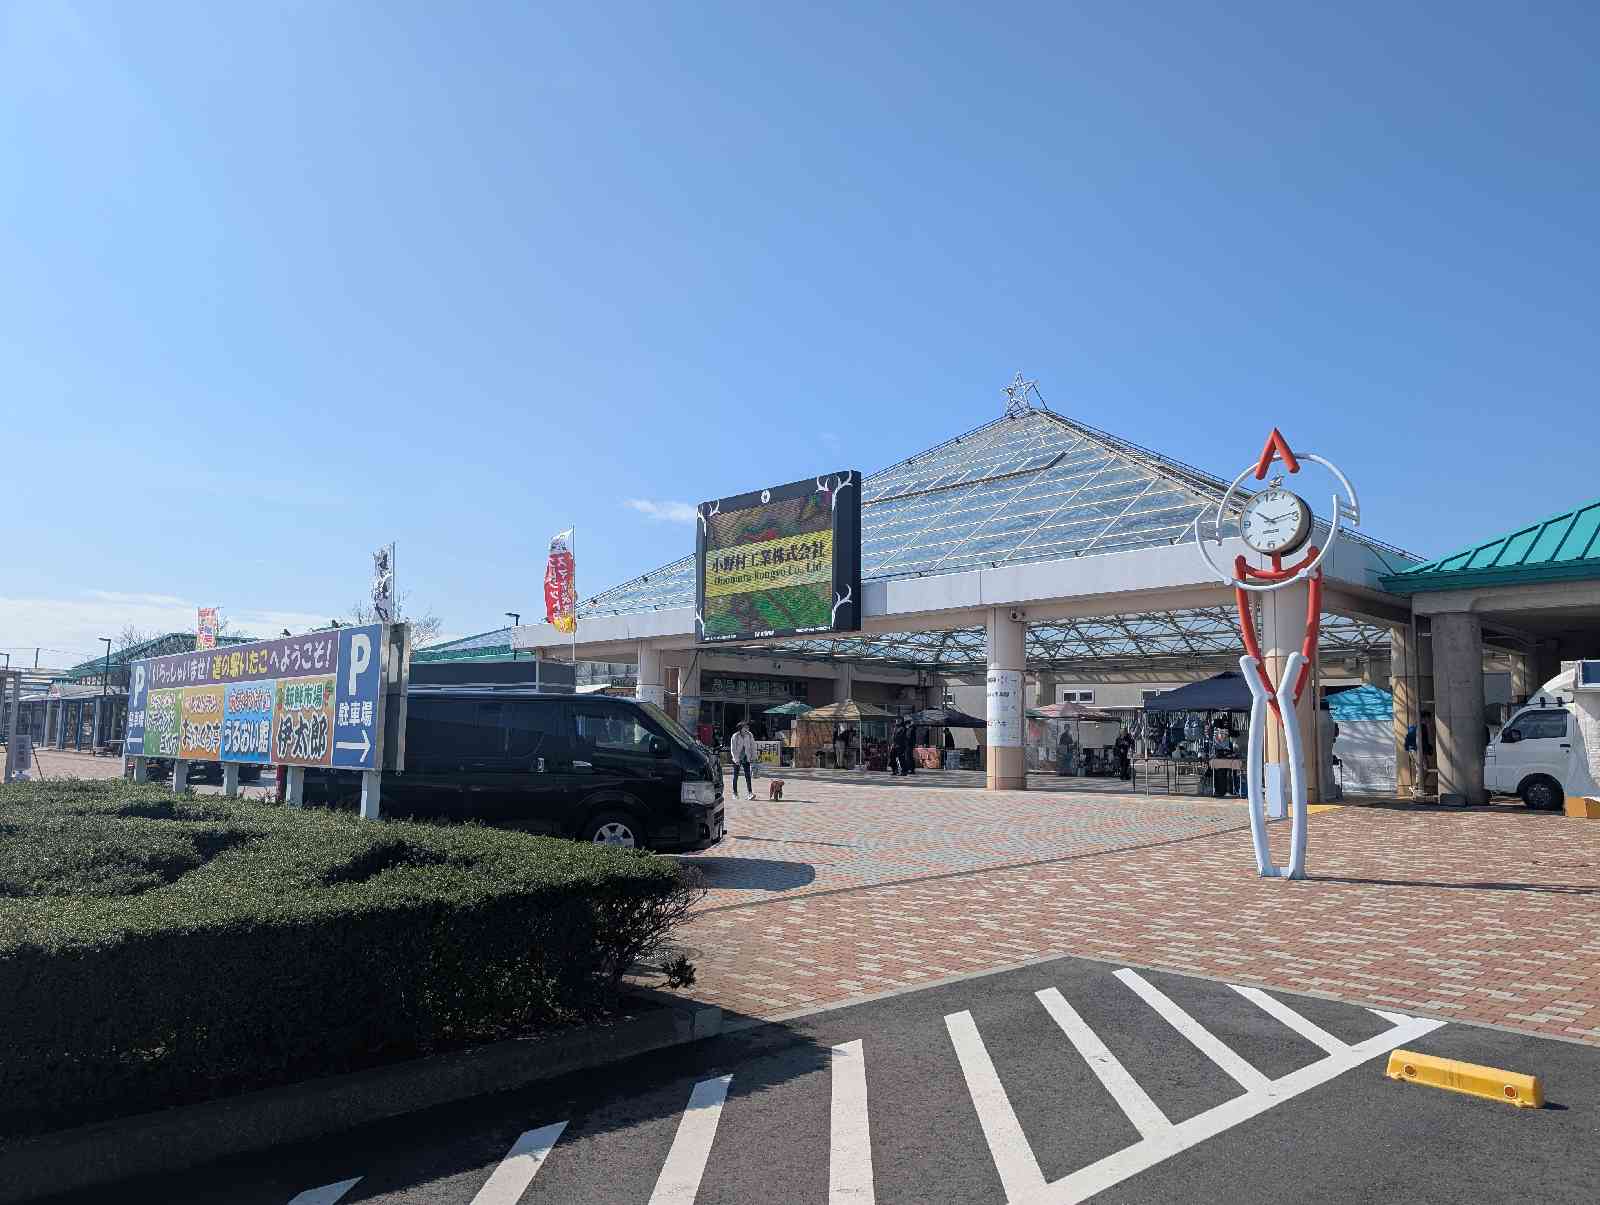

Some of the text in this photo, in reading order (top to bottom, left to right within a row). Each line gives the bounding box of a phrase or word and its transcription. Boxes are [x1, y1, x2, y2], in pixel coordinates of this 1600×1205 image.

[1264, 492, 1278, 503] 12
[348, 633, 371, 696] P
[133, 663, 145, 706] P
[284, 682, 323, 711] 新鮮市場
[338, 701, 373, 727] 駐車場
[223, 719, 270, 753] うるおい館
[276, 712, 328, 762] 伊太郎
